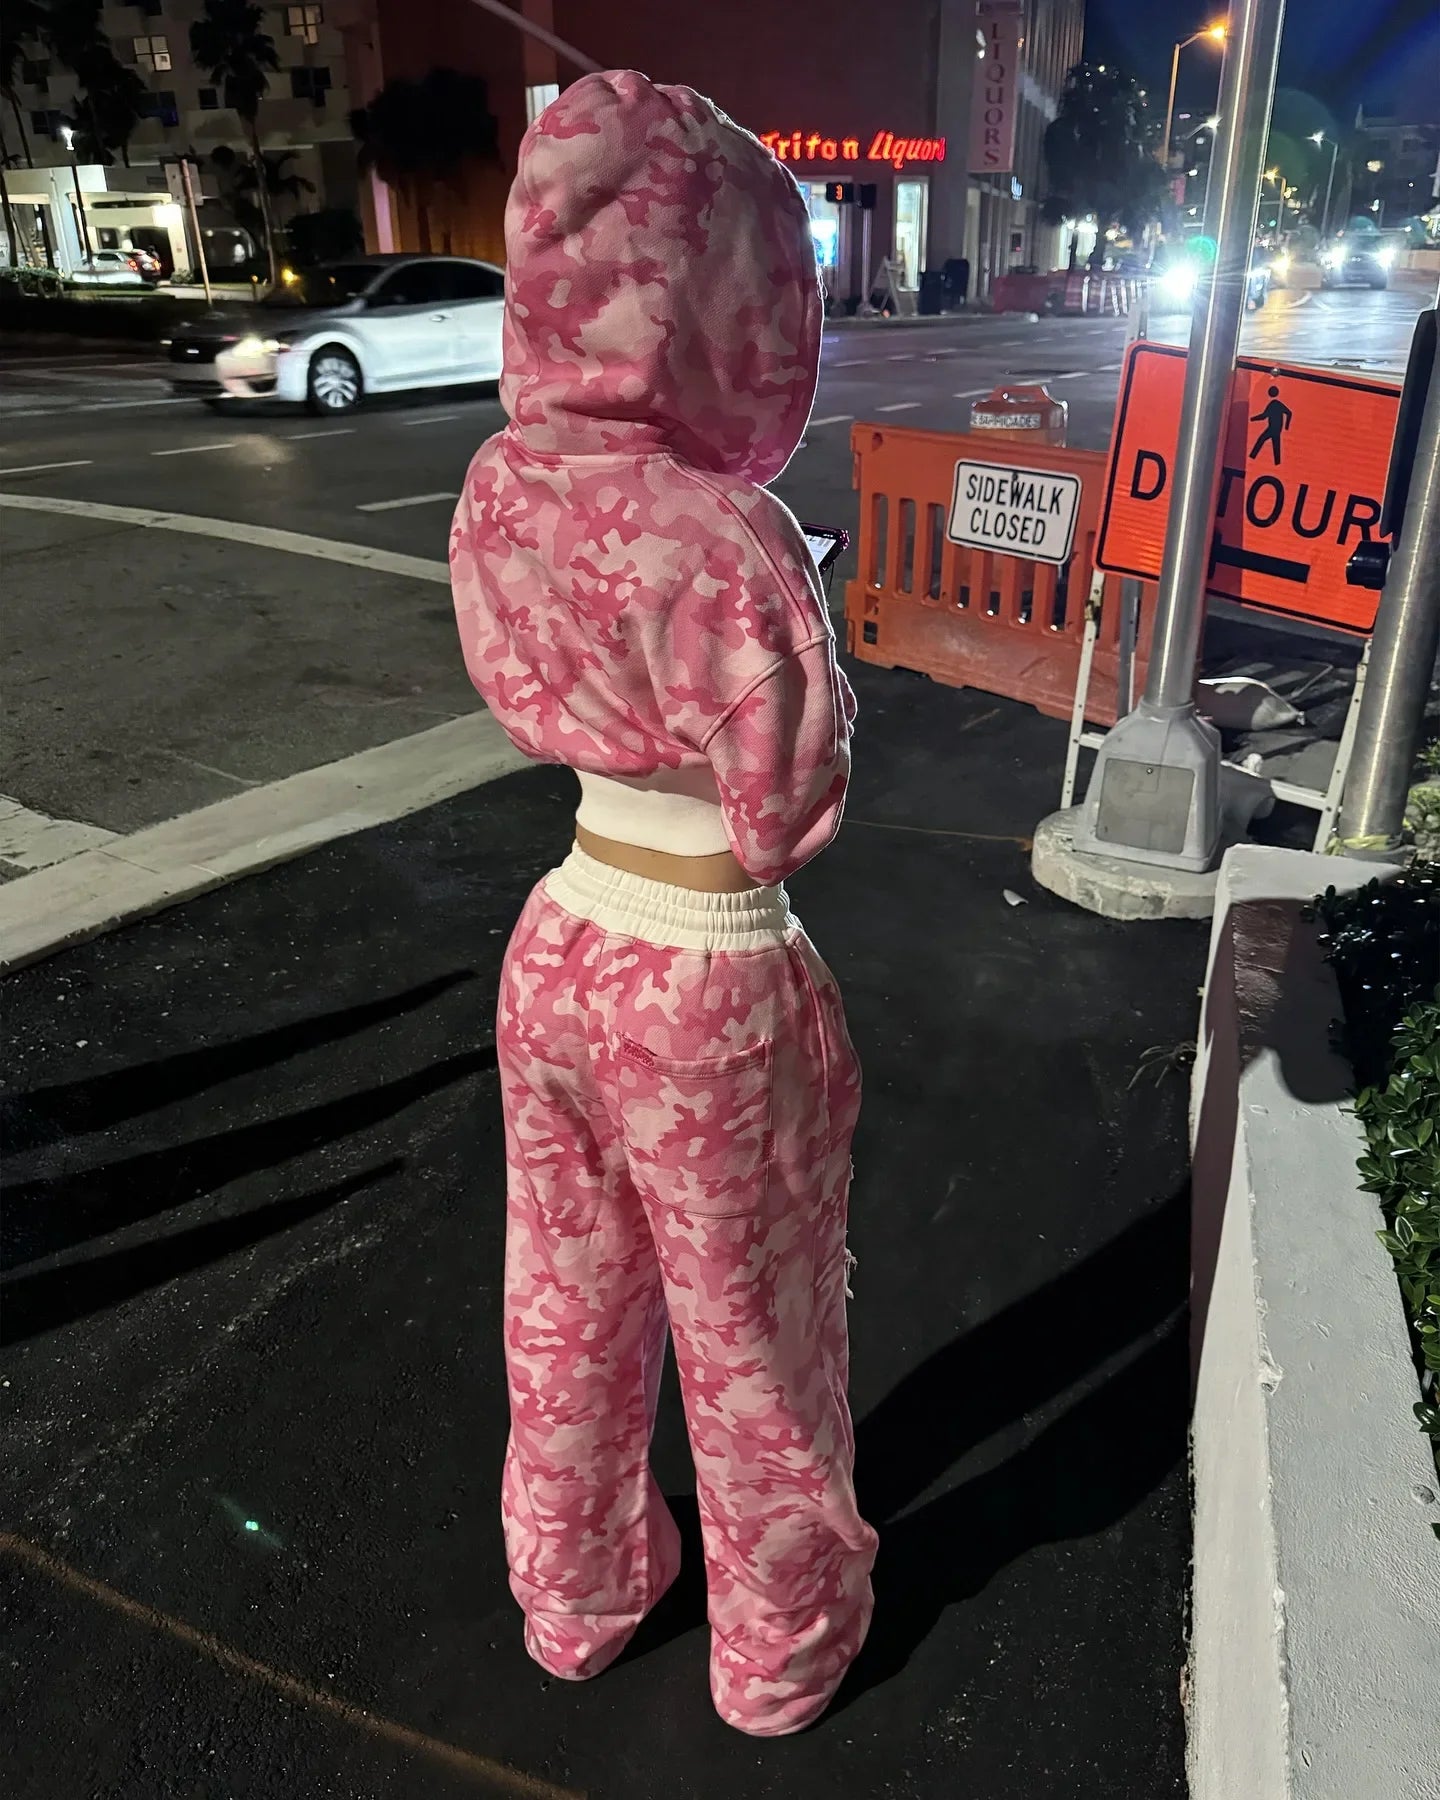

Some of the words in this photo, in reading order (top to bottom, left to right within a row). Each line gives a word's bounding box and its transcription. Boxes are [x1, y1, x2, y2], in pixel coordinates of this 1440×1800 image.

[984, 22, 1005, 166] LIQUORS
[760, 130, 859, 160] Triton
[966, 473, 1064, 515] SIDEWALK
[1130, 449, 1383, 546] DTOUR
[970, 507, 1046, 546] CLOSED
